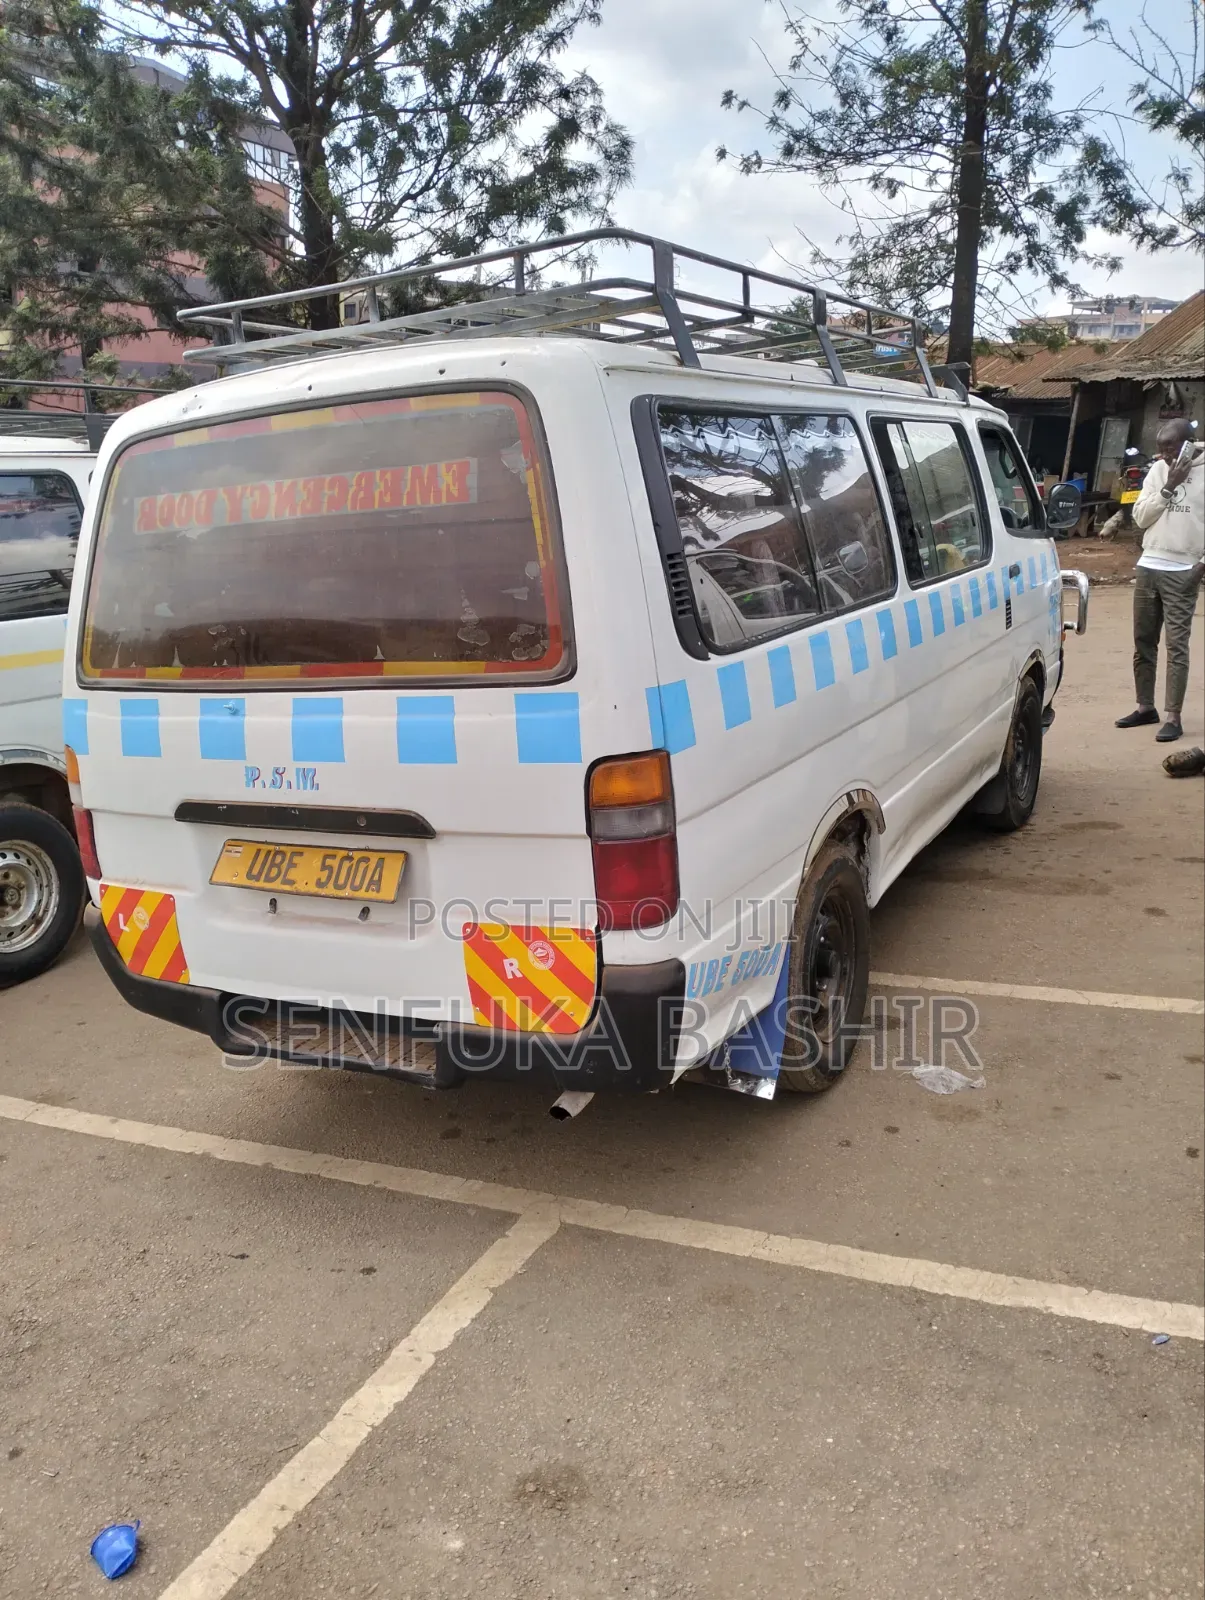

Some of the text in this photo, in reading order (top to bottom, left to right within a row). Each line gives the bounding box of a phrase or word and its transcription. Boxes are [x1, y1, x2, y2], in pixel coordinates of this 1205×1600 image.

[245, 848, 386, 893] UBE 500A
[118, 912, 130, 933] L
[502, 957, 523, 979] R
[686, 955, 733, 1001] UBE
